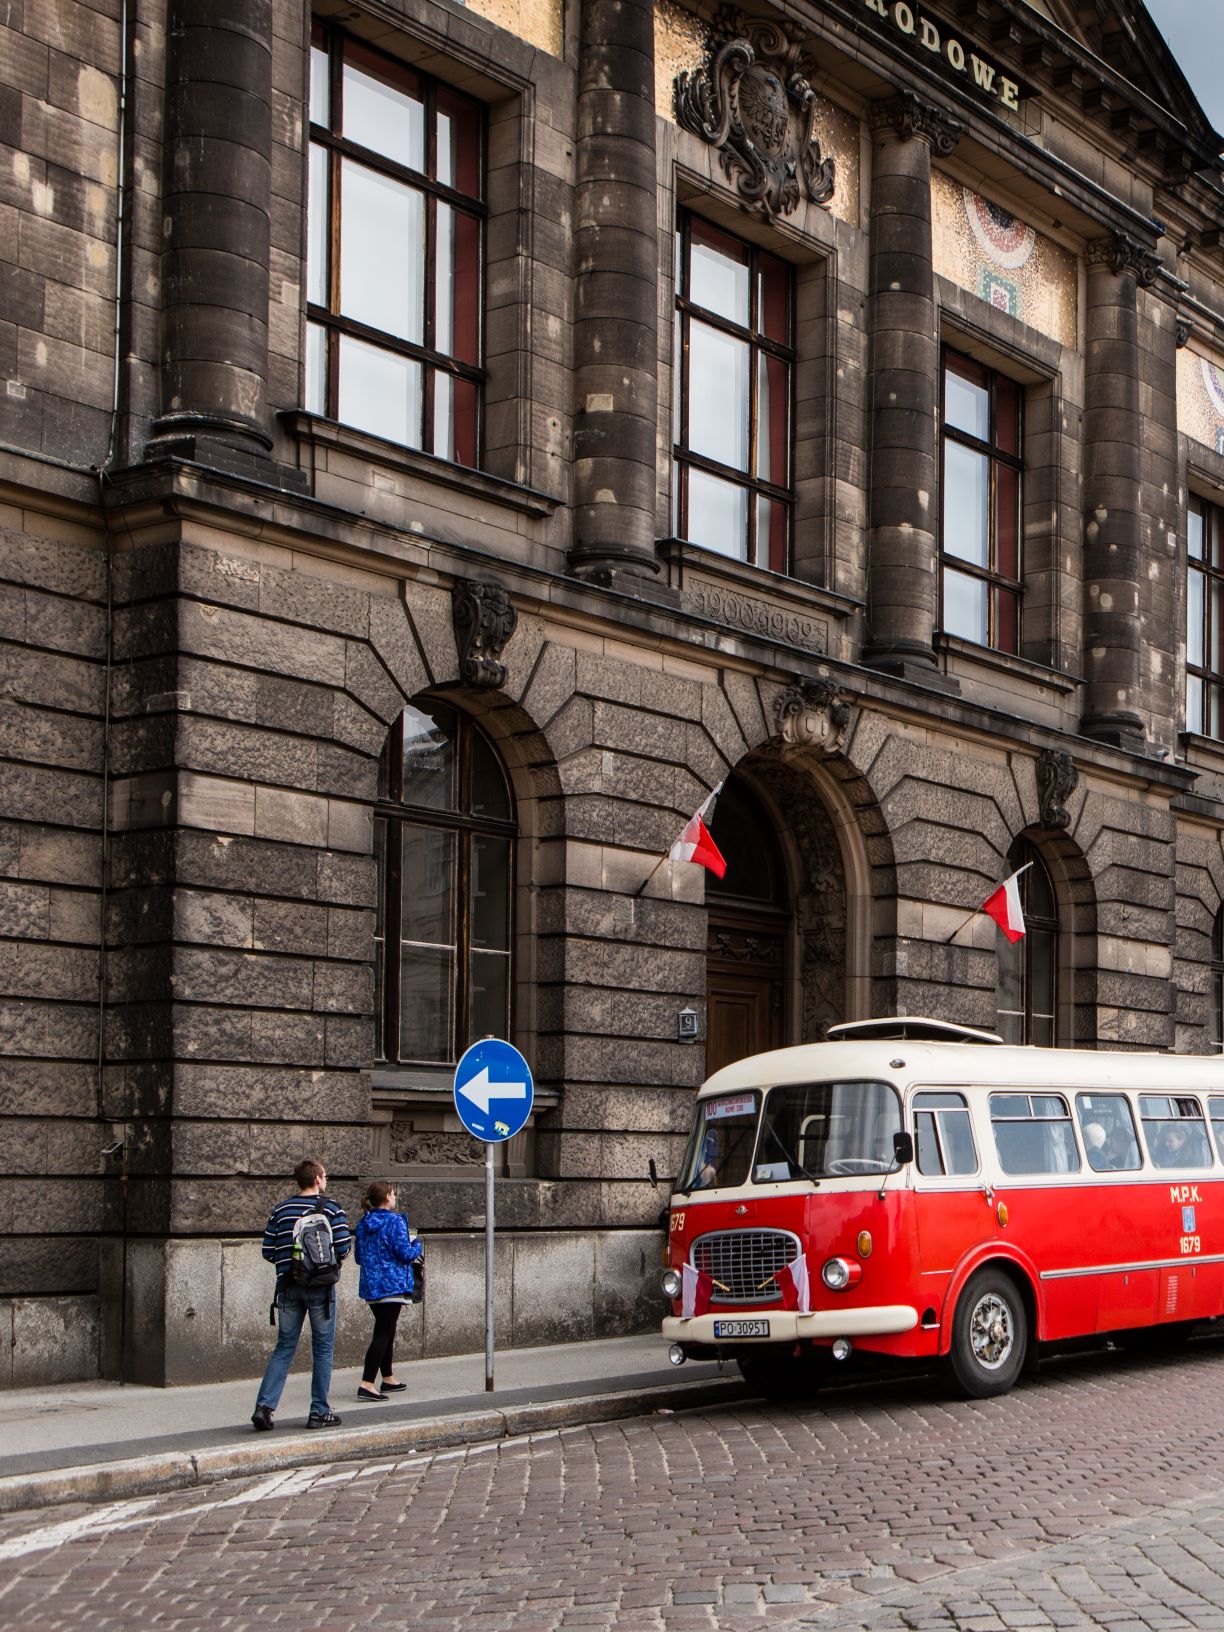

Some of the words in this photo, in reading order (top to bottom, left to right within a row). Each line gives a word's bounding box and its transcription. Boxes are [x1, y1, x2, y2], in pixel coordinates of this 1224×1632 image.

[1170, 1185, 1203, 1203] M.P.K.
[1180, 1235, 1200, 1254] 1679
[720, 1322, 734, 1335] PO
[737, 1321, 767, 1335] 3095T
